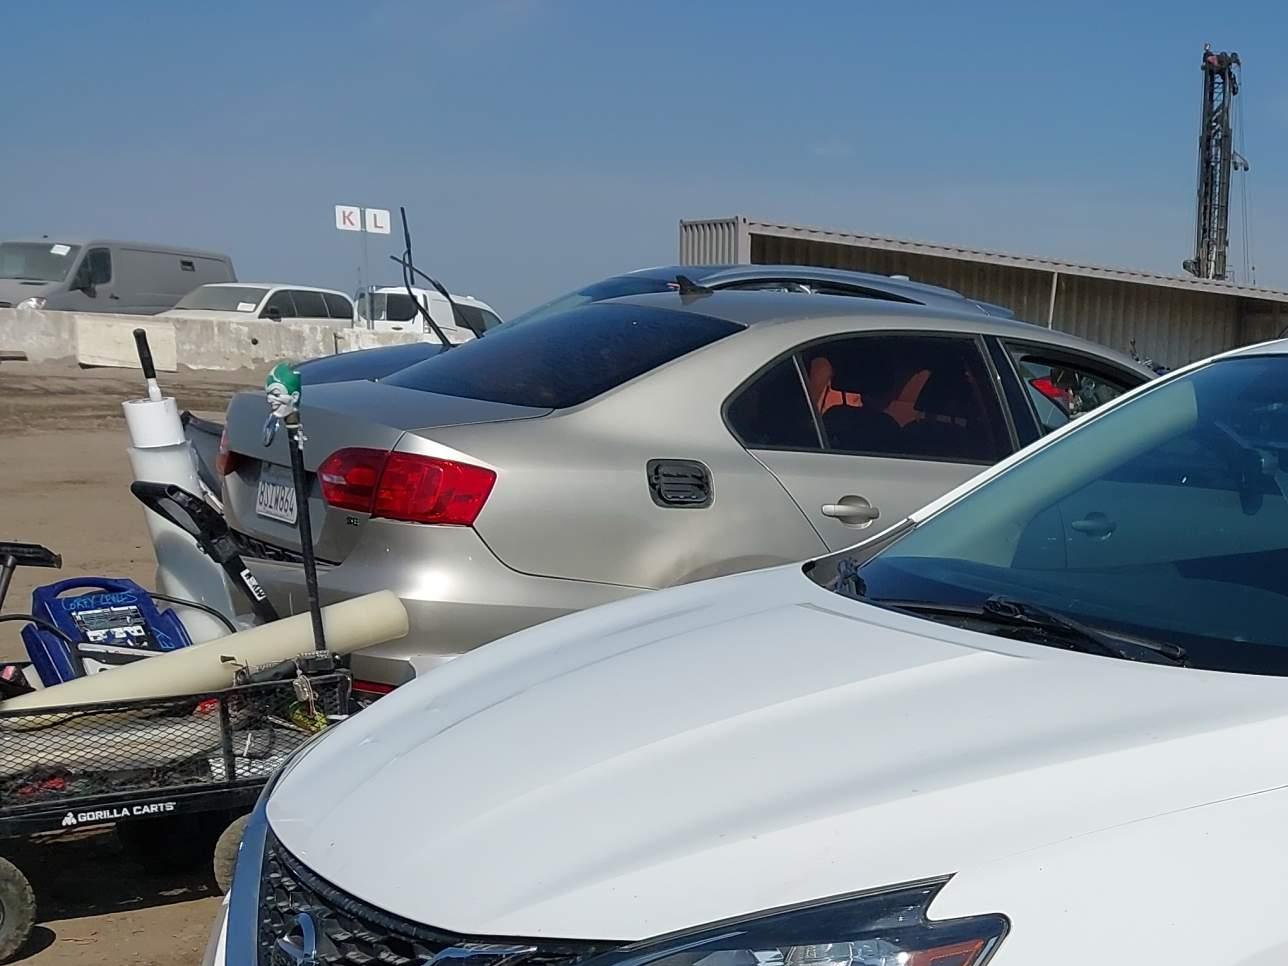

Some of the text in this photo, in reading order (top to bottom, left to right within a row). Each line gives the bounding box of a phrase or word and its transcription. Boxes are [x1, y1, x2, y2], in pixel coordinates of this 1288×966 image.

[342, 210, 355, 226] K
[373, 213, 384, 229] L
[77, 802, 175, 822] GORILLA CARTS
